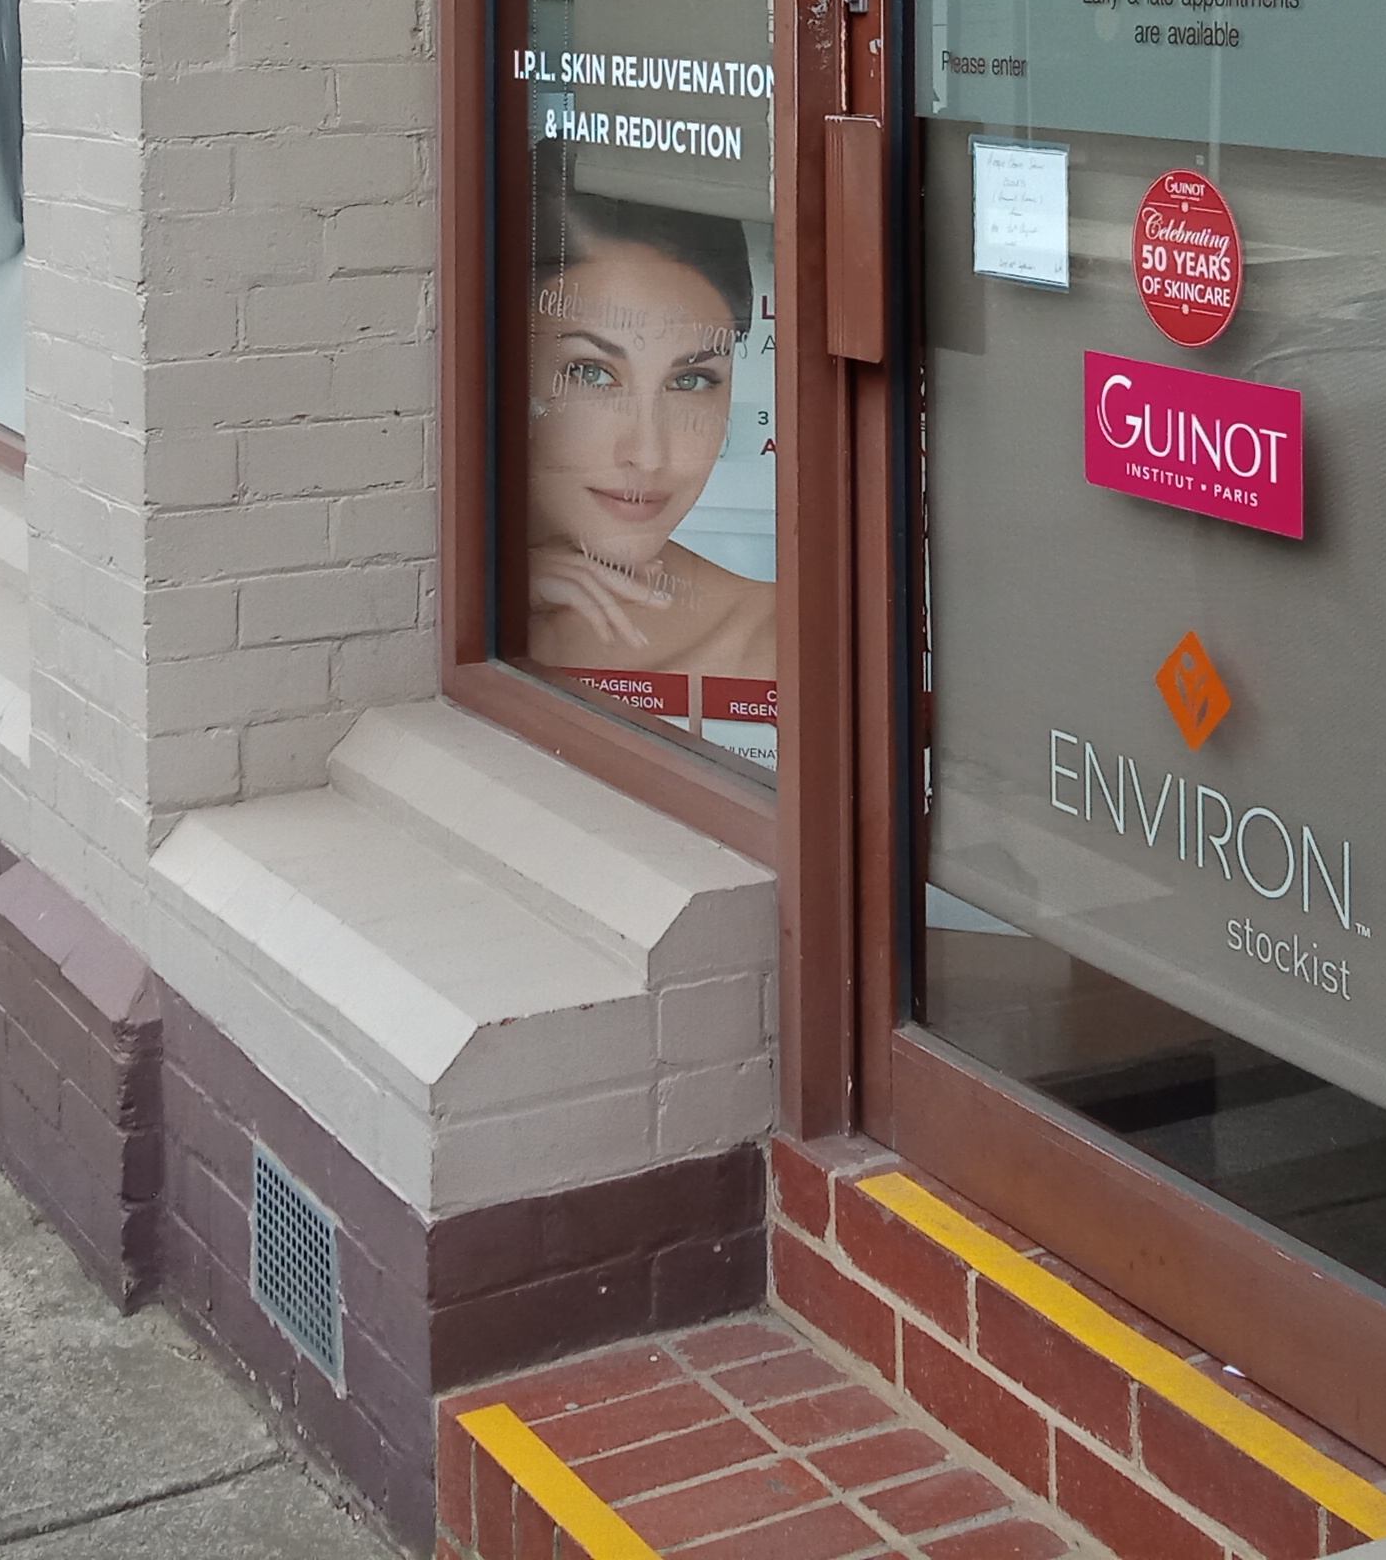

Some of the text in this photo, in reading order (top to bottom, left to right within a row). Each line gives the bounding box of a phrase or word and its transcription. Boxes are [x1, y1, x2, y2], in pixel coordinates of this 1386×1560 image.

[1134, 21, 1240, 47] are available
[513, 49, 557, 82] I.P.L.
[560, 52, 605, 86] SKIN
[941, 50, 1027, 77] Please enter
[544, 109, 743, 160] & HAIR REDUCTION
[1164, 175, 1205, 197] GUINOT
[1142, 206, 1230, 259] Celebrating
[1142, 244, 1231, 282] 50 YEARS
[1142, 275, 1231, 308] OF SKINCARE
[1097, 374, 1288, 484] GUINOT
[1126, 462, 1259, 507] INSTITUT PARIS
[1050, 728, 1351, 930] ENVIRON
[1226, 917, 1352, 1001] stockist
